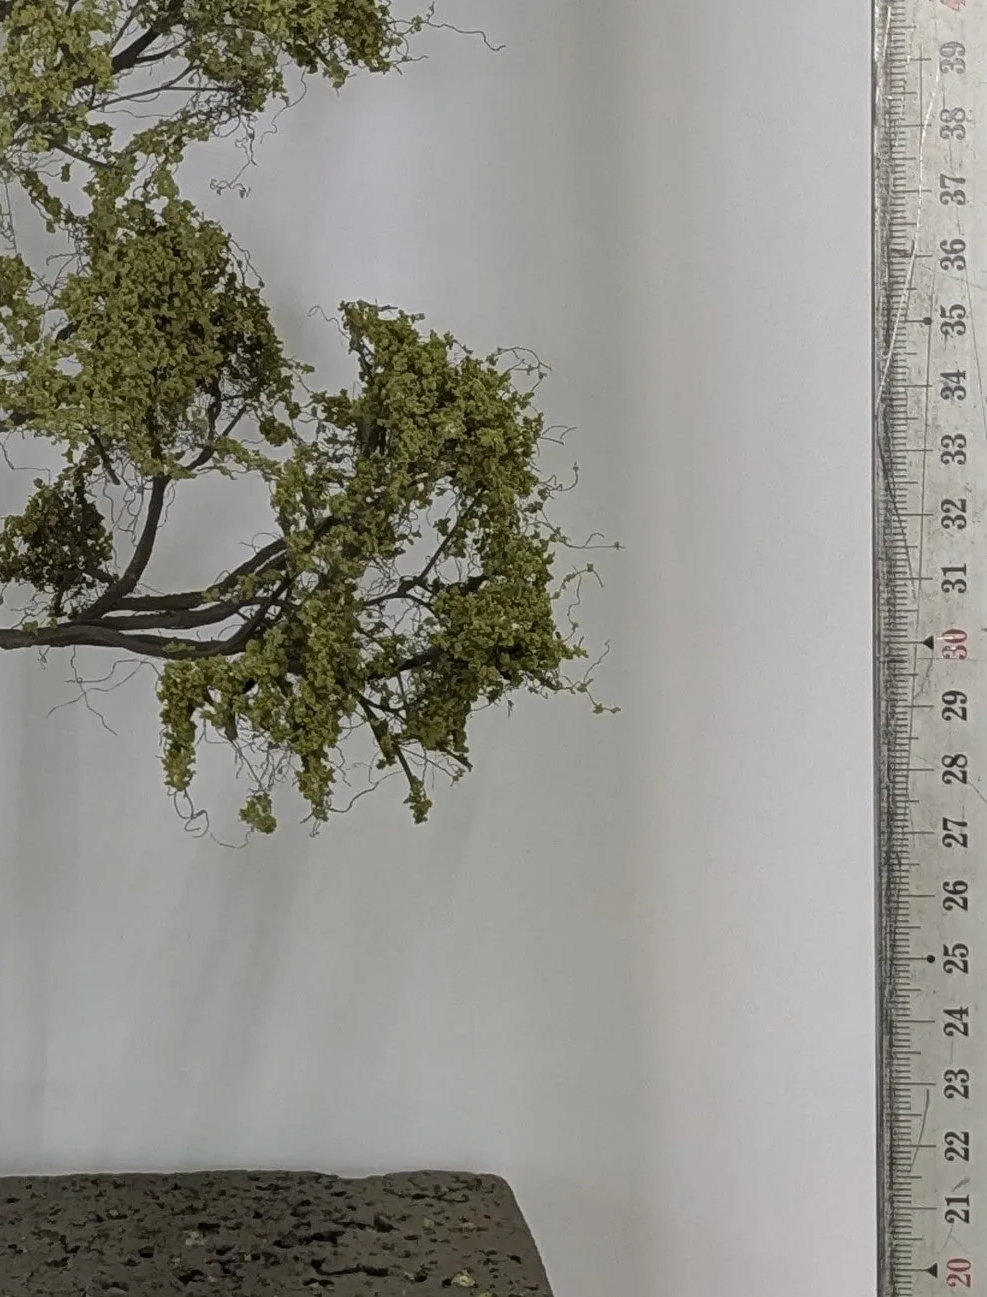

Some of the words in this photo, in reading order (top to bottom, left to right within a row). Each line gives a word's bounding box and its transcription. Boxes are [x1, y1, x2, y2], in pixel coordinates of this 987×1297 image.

[939, 41, 966, 74] 39
[940, 107, 966, 140] 38
[940, 174, 966, 205] 37
[939, 239, 966, 271] 36
[940, 304, 966, 336] 35
[940, 369, 966, 400] 34
[941, 434, 966, 465] 33
[941, 499, 967, 530] 32
[941, 563, 967, 593] 31
[942, 629, 967, 660] 30
[942, 691, 967, 721] 29
[942, 754, 967, 784] 28
[942, 817, 967, 848] 27
[943, 881, 968, 911] 26
[943, 944, 969, 974] 25
[943, 1007, 968, 1036] 24
[944, 1069, 969, 1099] 23
[944, 1132, 969, 1161] 22
[945, 1195, 969, 1224] 21
[946, 1259, 971, 1287] 20
